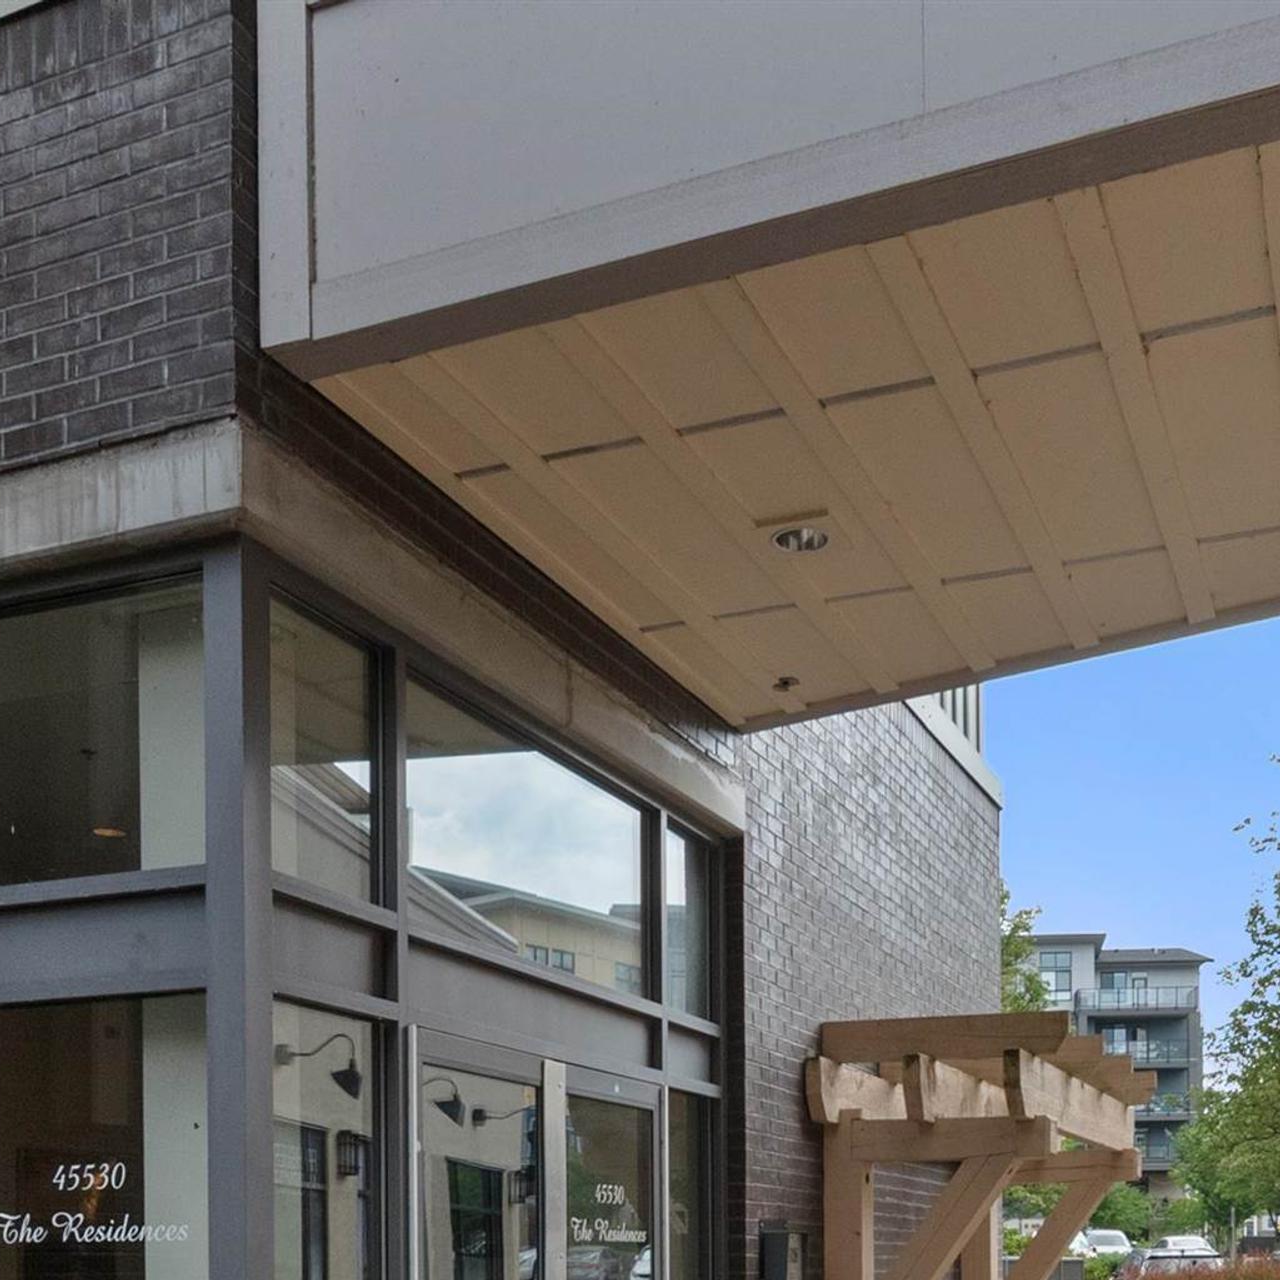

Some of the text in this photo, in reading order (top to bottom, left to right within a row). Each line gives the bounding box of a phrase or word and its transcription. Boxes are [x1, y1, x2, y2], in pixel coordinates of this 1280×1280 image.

[53, 1162, 126, 1191] 45530
[595, 1183, 625, 1205] 45530
[51, 1211, 189, 1243] Residences
[570, 1217, 648, 1243] The Residences
